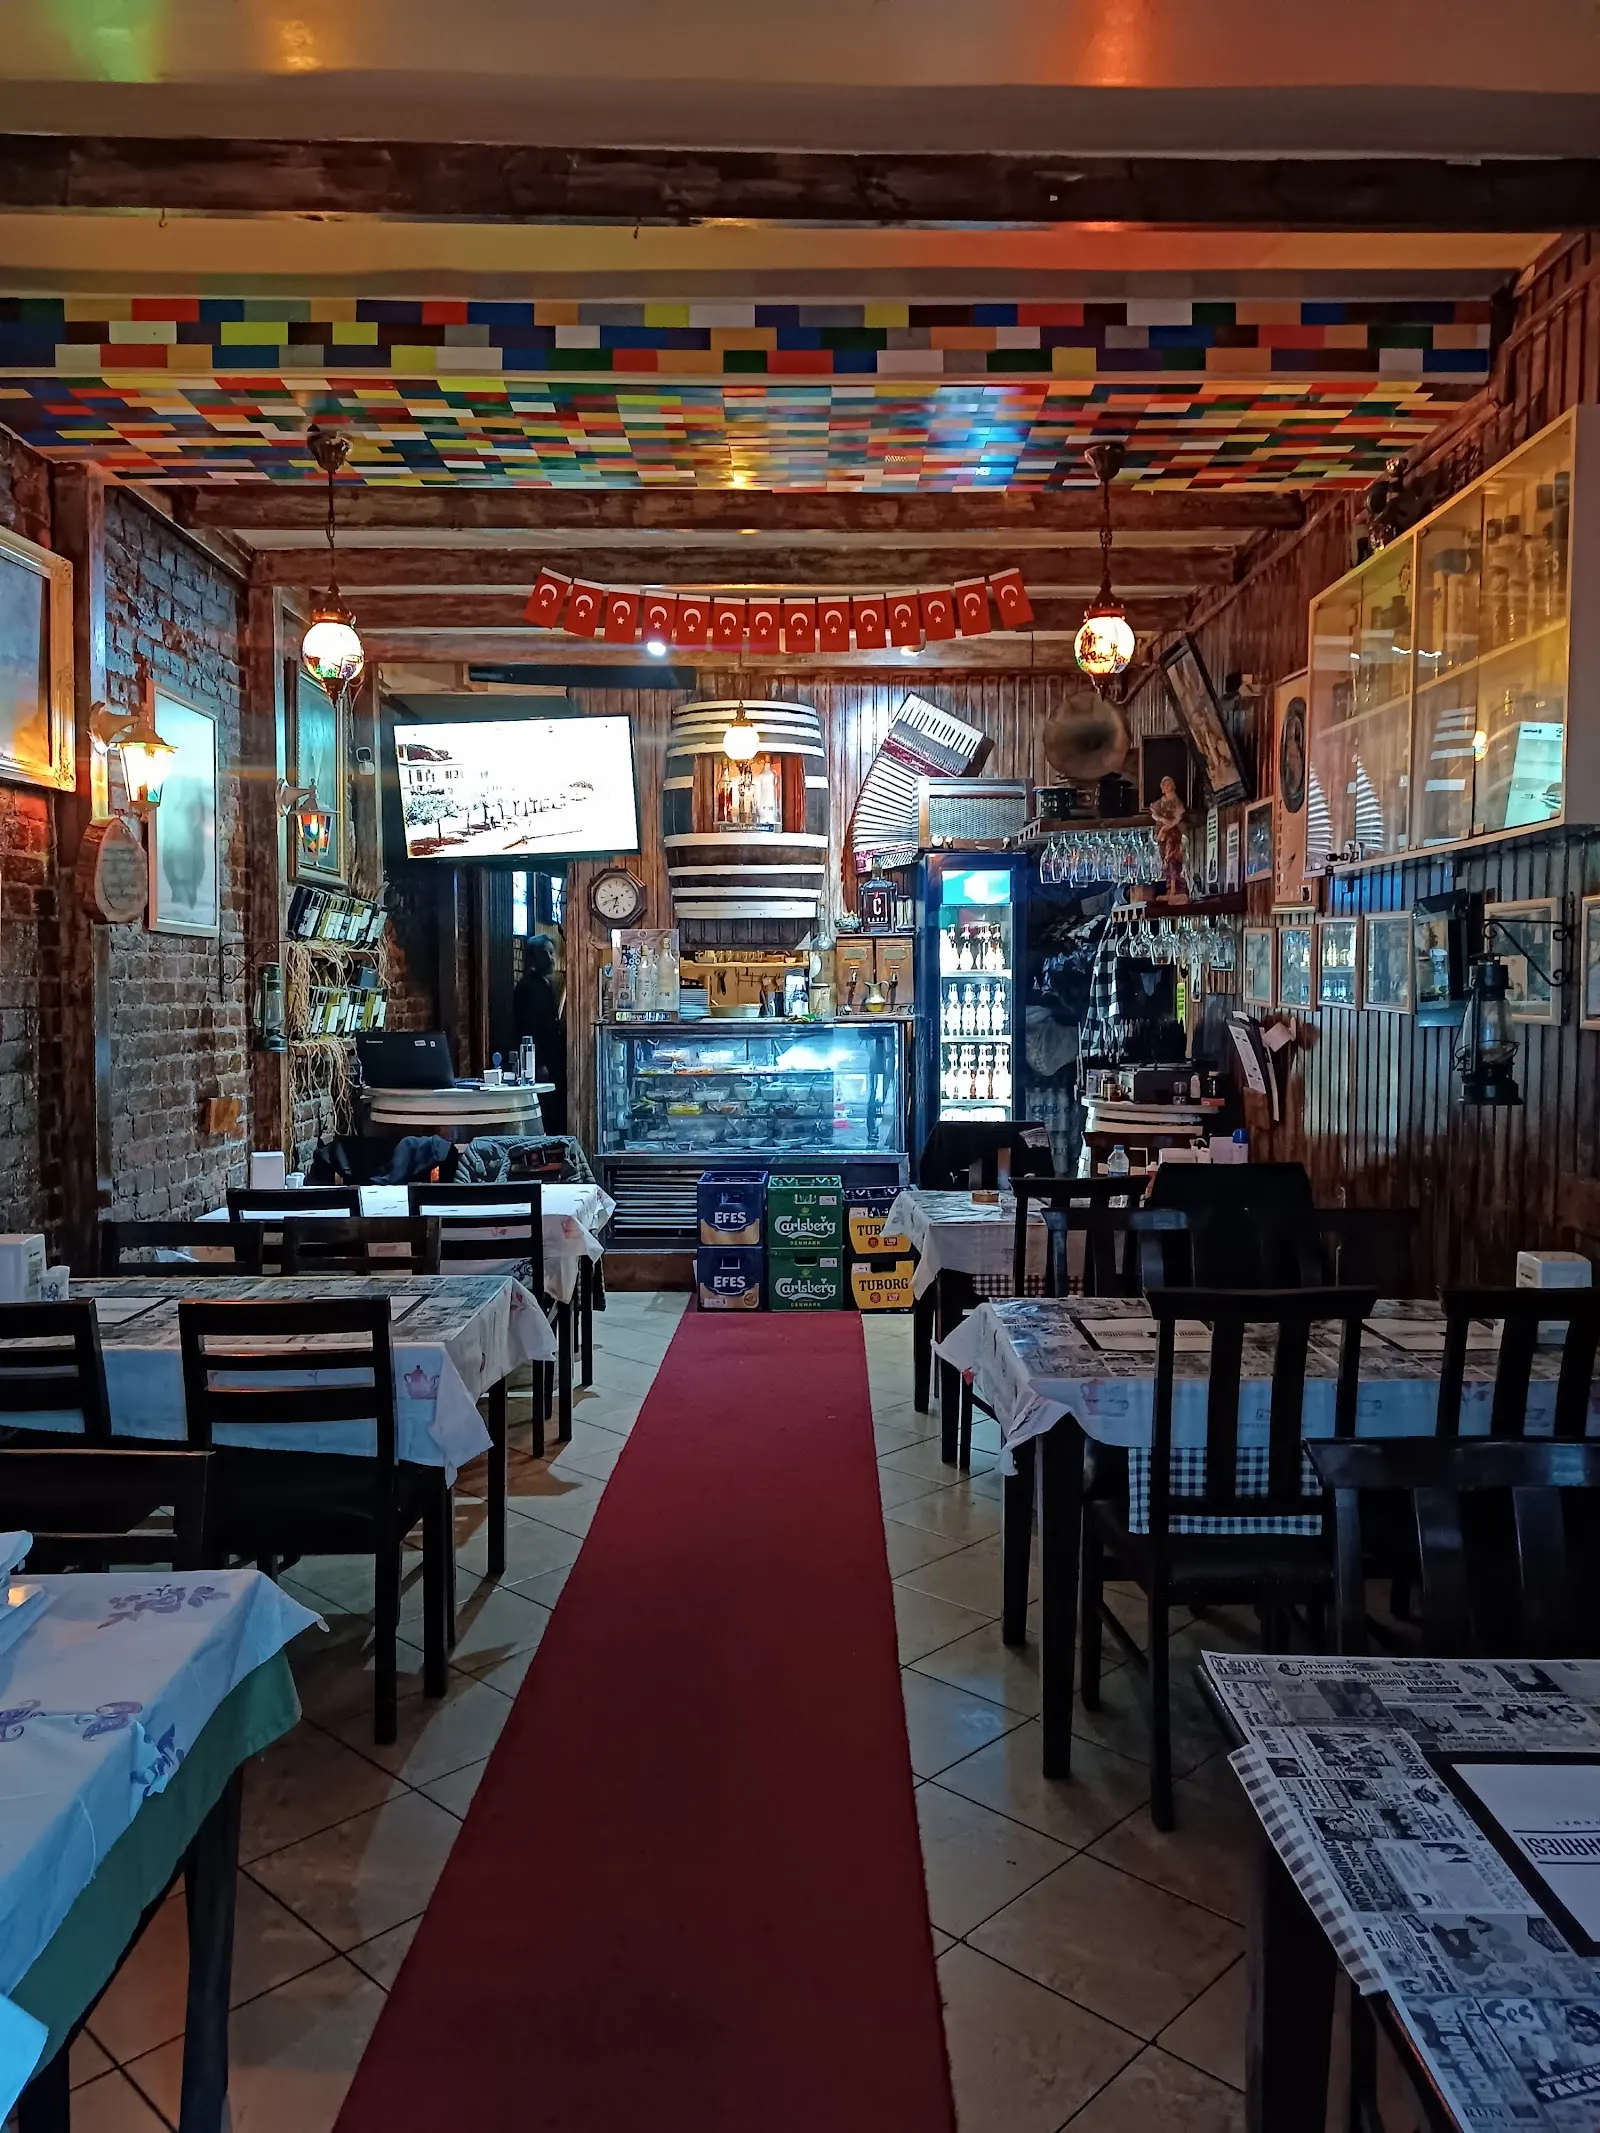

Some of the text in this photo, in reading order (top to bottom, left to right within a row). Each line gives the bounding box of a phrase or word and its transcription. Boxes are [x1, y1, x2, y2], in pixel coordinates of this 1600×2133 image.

[714, 1211, 747, 1224] EFES
[774, 1215, 836, 1239] Carlsberg
[856, 1224, 886, 1236] TUB
[713, 1275, 746, 1288] EFES
[858, 1278, 909, 1292] TUBORG
[774, 1278, 837, 1301] Carlsberg
[1484, 1999, 1534, 2027] Ses
